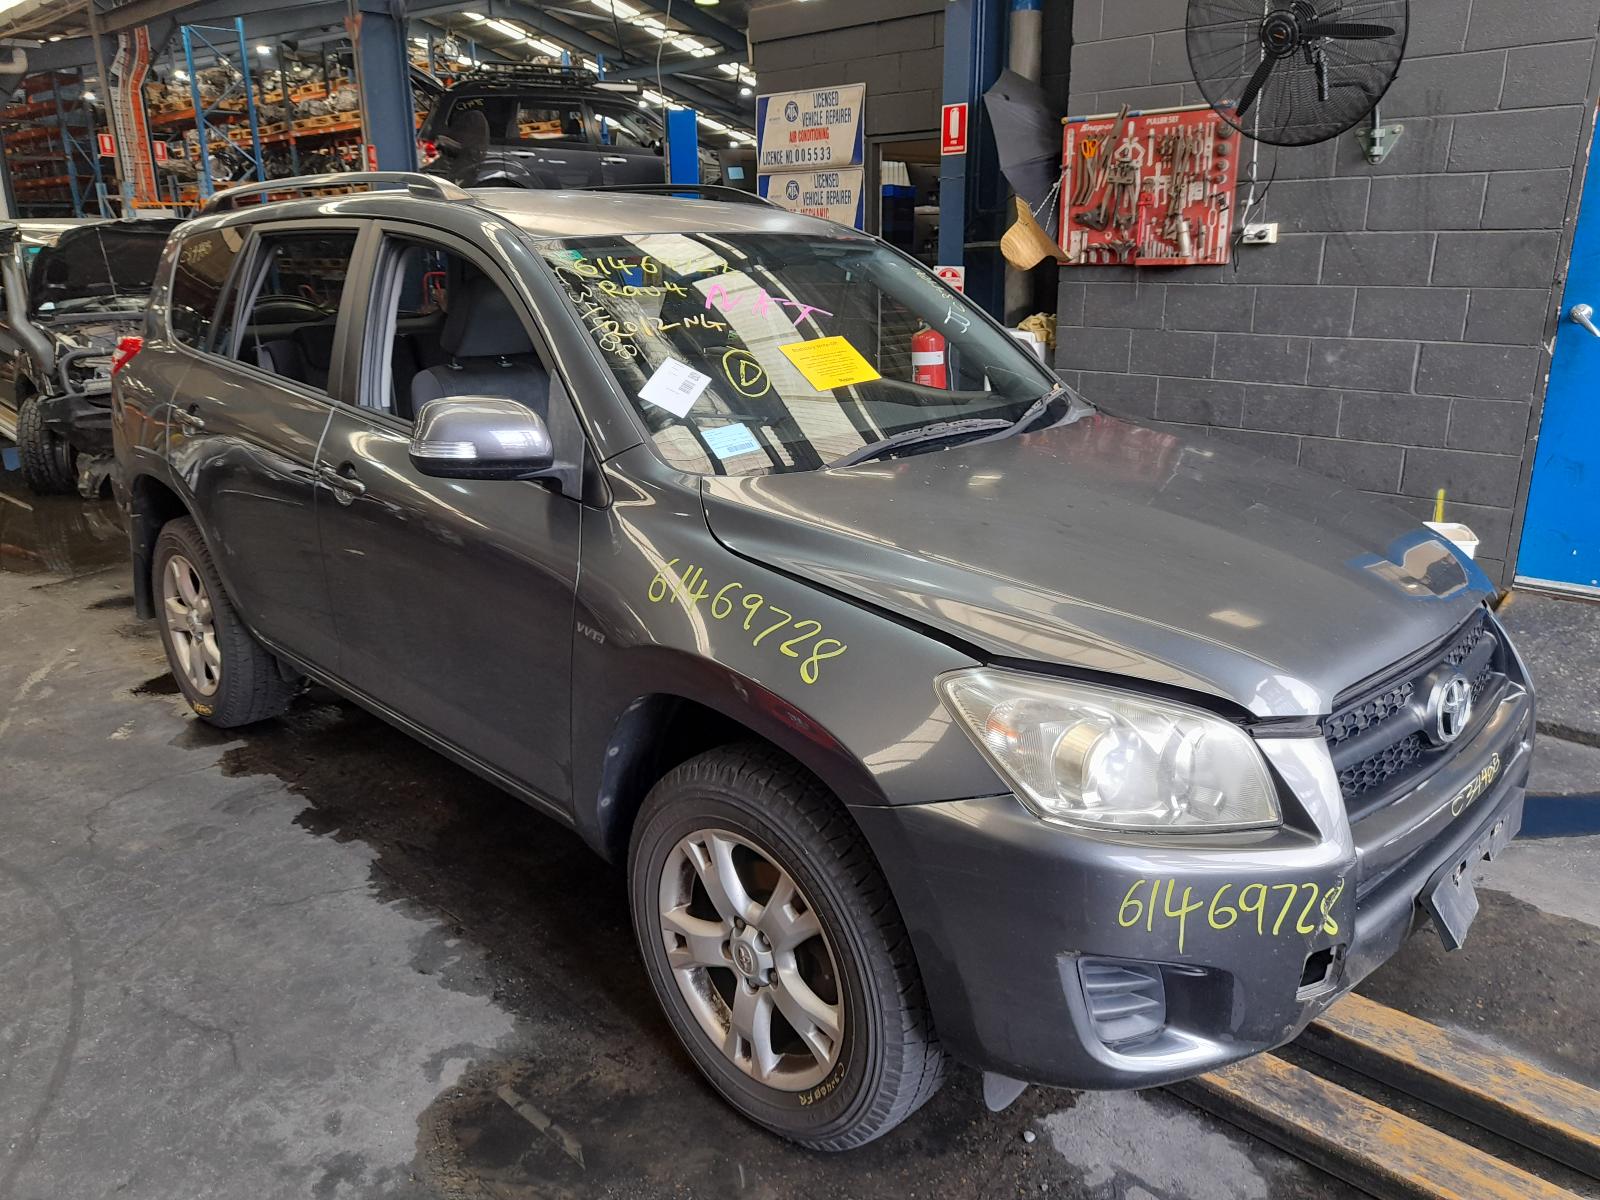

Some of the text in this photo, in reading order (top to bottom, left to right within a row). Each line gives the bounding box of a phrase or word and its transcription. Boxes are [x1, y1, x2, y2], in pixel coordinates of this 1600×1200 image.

[812, 91, 839, 109] LICENSED
[801, 107, 852, 127] VEHICLE REPAIRER
[789, 127, 830, 143] AIR CONDITIONING
[762, 150, 783, 166] LICENCE
[813, 172, 839, 189] LICENSED
[802, 189, 852, 206] VEHICLE REPAIRER
[647, 557, 848, 685] 61469728
[1117, 877, 1345, 956] 61469728
